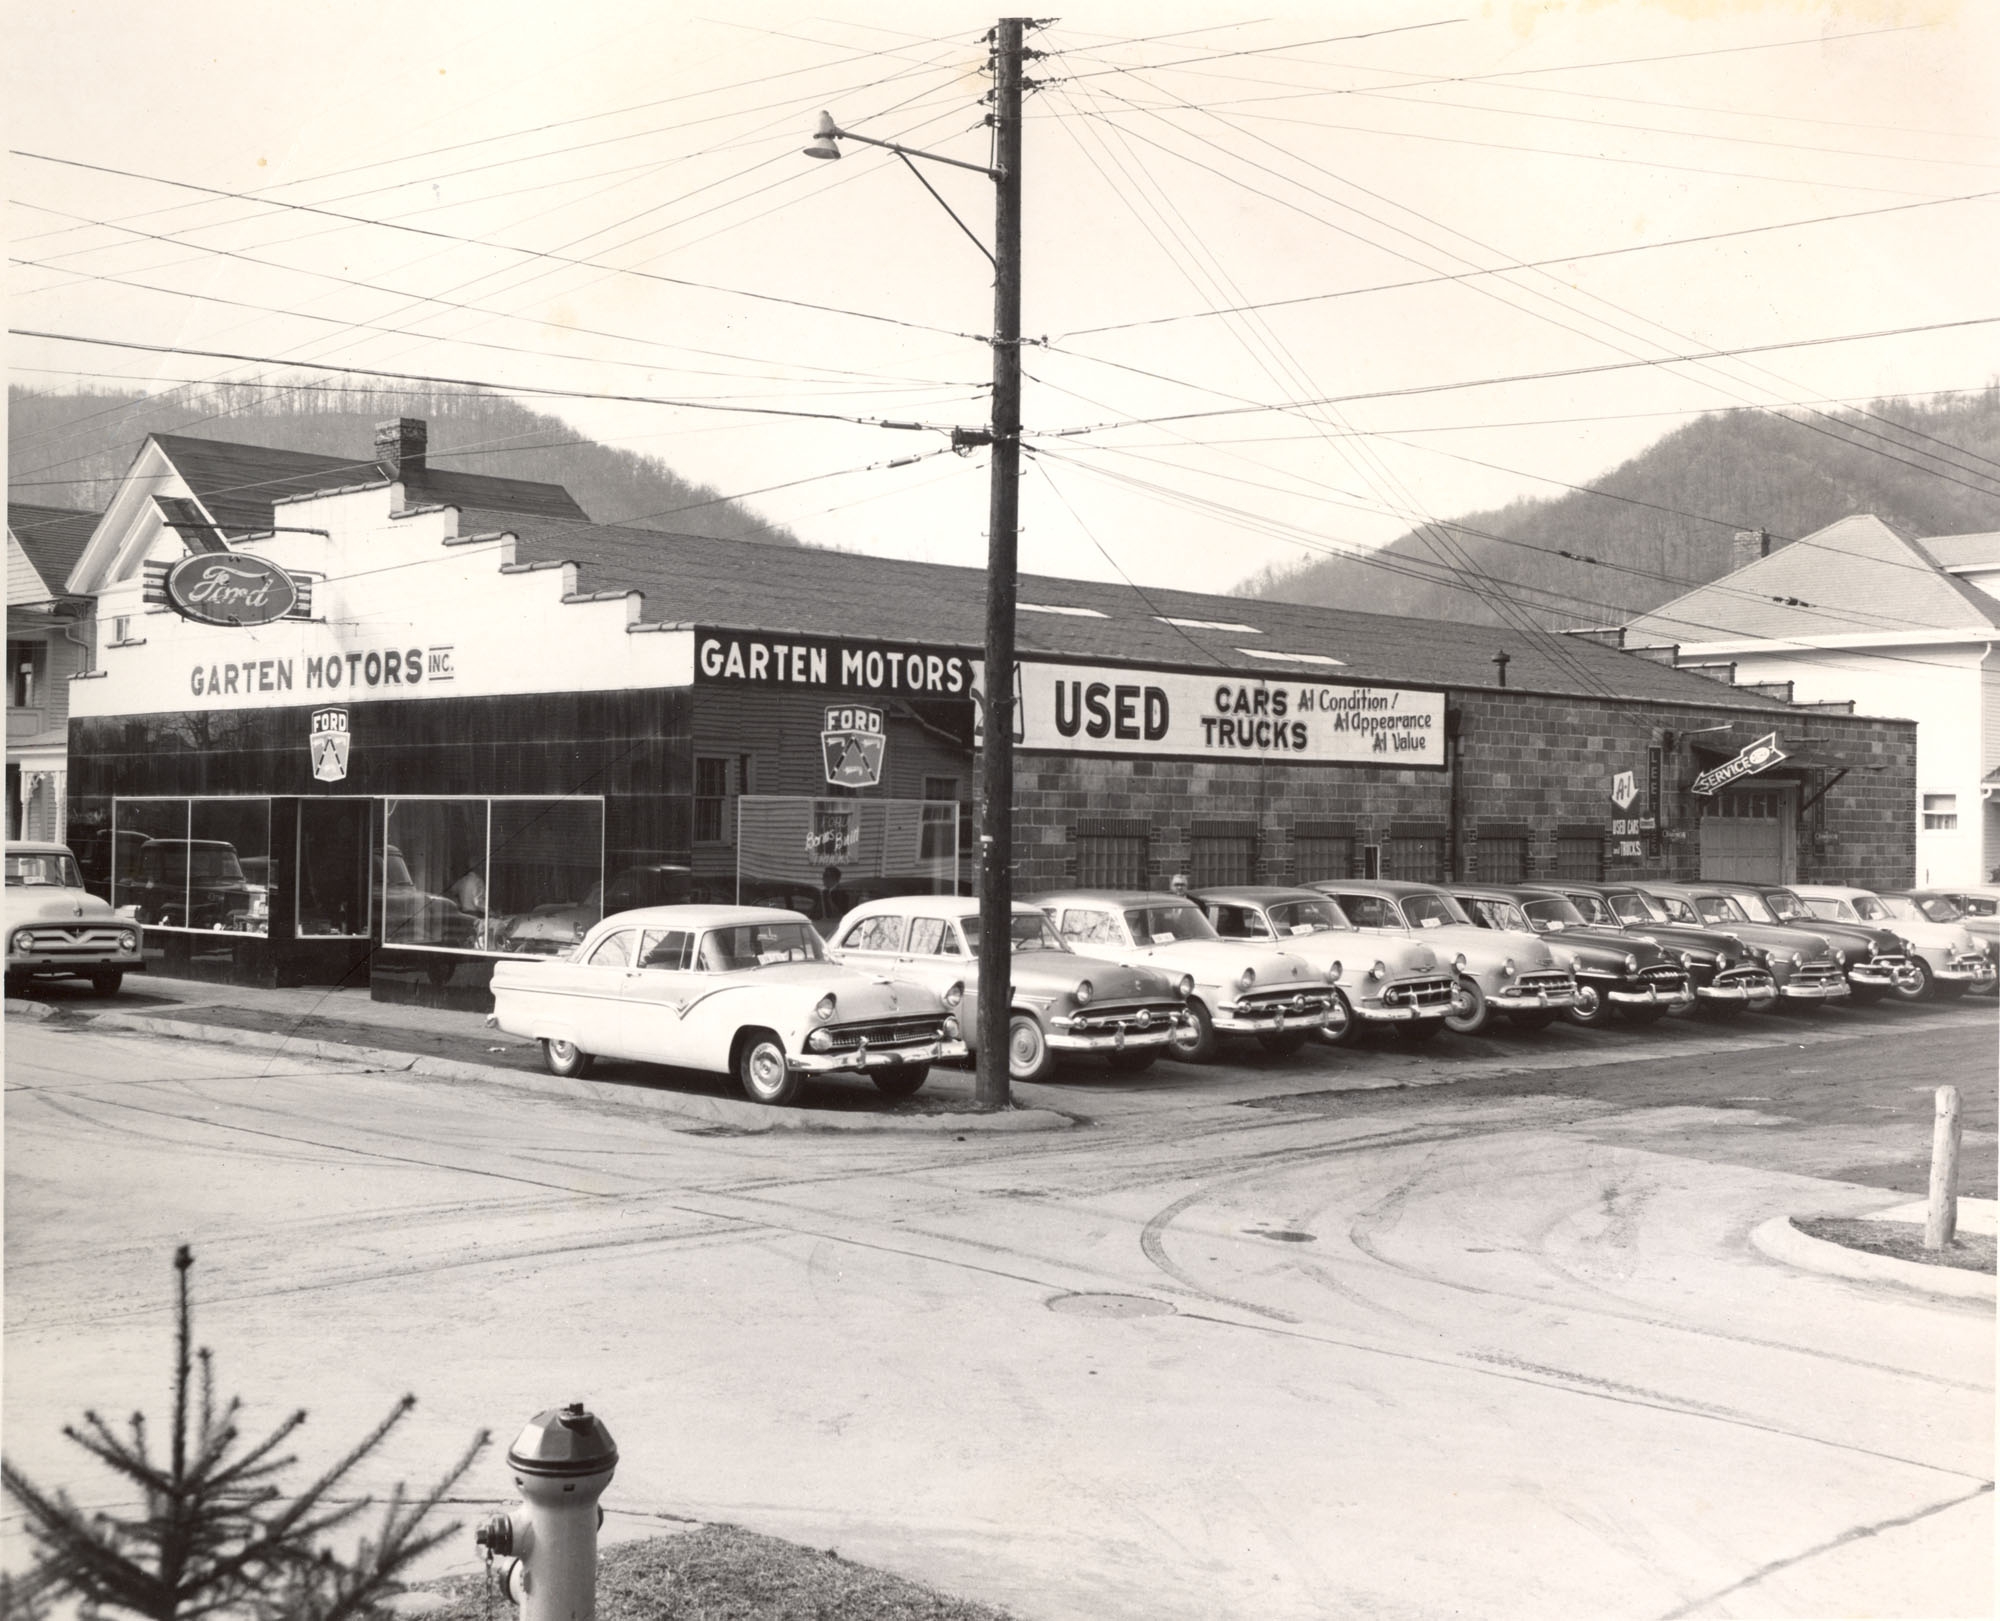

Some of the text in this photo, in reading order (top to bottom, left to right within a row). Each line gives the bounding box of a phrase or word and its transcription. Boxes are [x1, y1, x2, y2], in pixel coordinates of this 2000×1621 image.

[188, 565, 273, 607] Ford
[190, 648, 454, 697] GARTEN MOTORS INC.
[700, 638, 963, 693] GARTEN MOTORS
[1054, 680, 1170, 741] USED
[1215, 686, 1288, 716] CARS
[313, 712, 347, 733] FORD
[827, 710, 881, 733] FORD
[1201, 717, 1308, 750] TRUCKS
[1392, 732, 1426, 753] Value
[1699, 756, 1751, 791] SERVICE
[1612, 819, 1626, 835] USED
